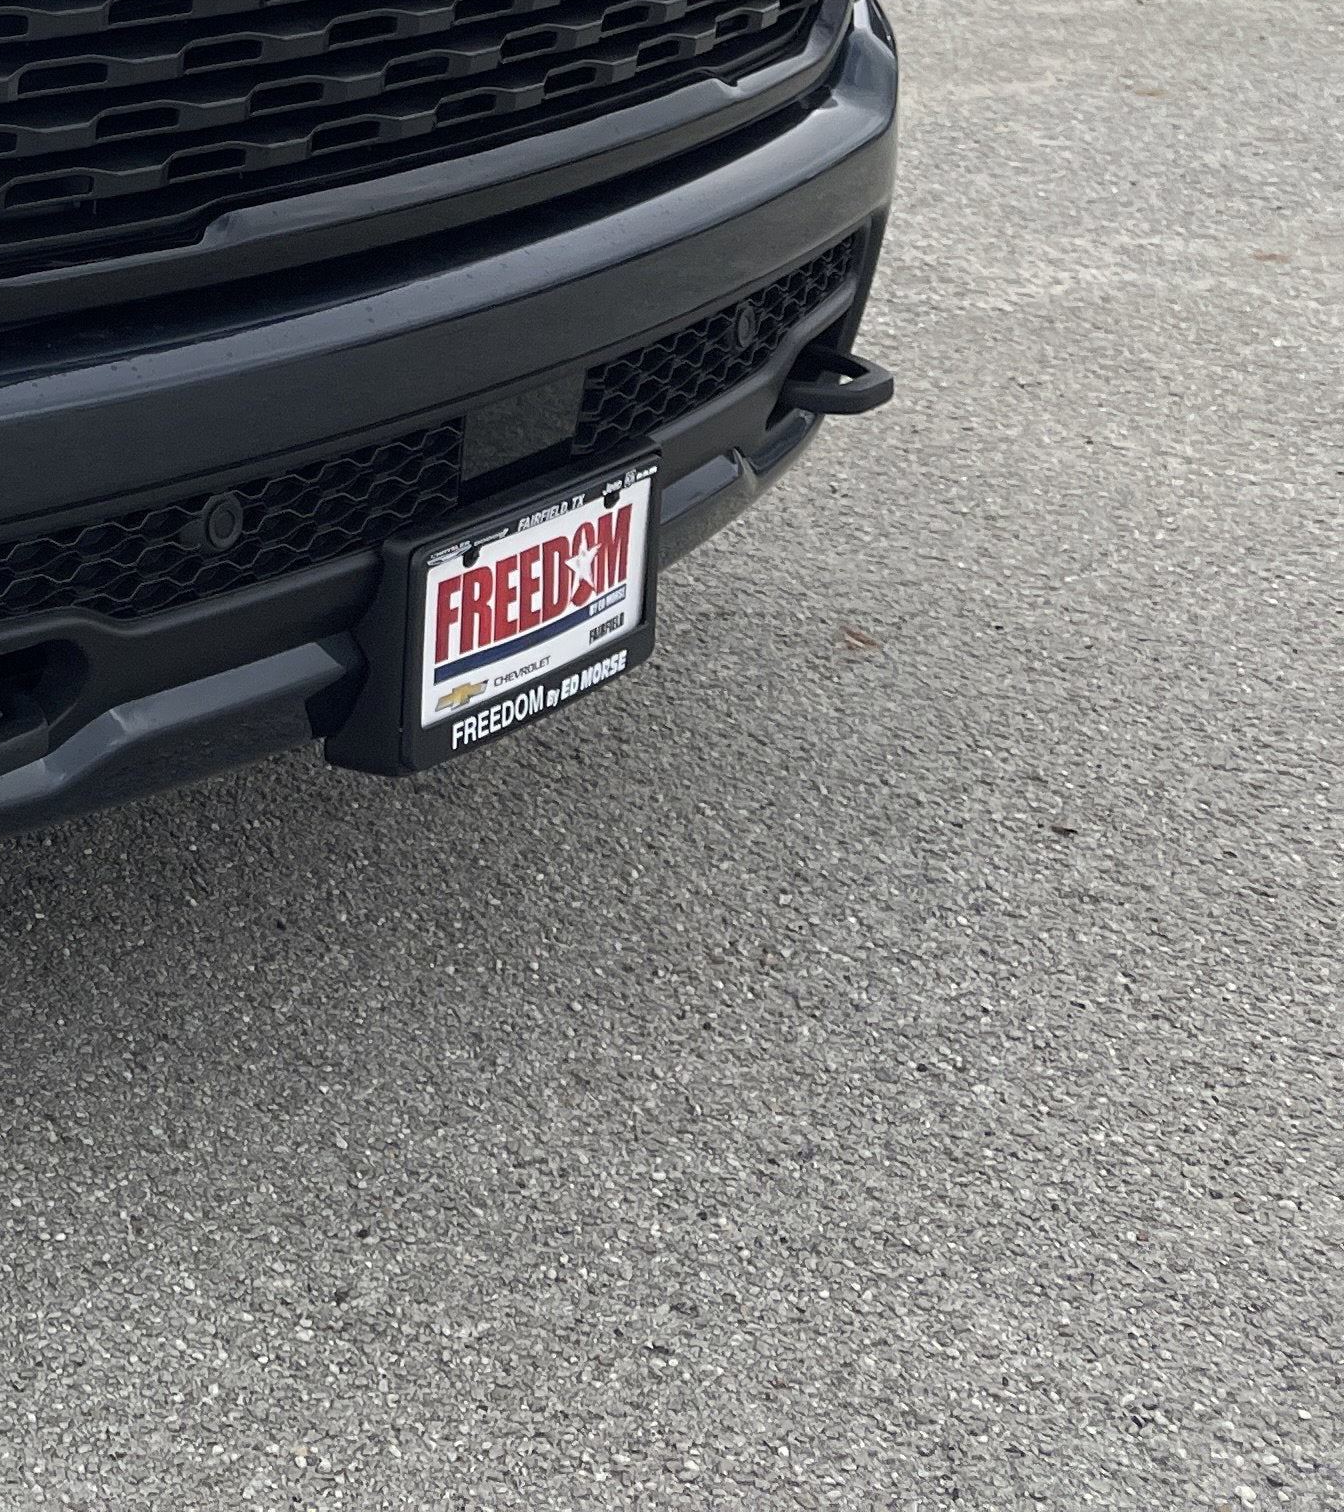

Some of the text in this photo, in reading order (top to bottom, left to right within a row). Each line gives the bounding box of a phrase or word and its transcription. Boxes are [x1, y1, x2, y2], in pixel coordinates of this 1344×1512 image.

[572, 493, 586, 510] TX
[434, 503, 633, 665] FREEDOM
[589, 612, 625, 645] FAIRFIELD
[493, 655, 551, 687] CHEVROLET
[451, 685, 544, 750] FREEDOM
[561, 674, 580, 701] ED
[580, 649, 628, 691] MORSE
